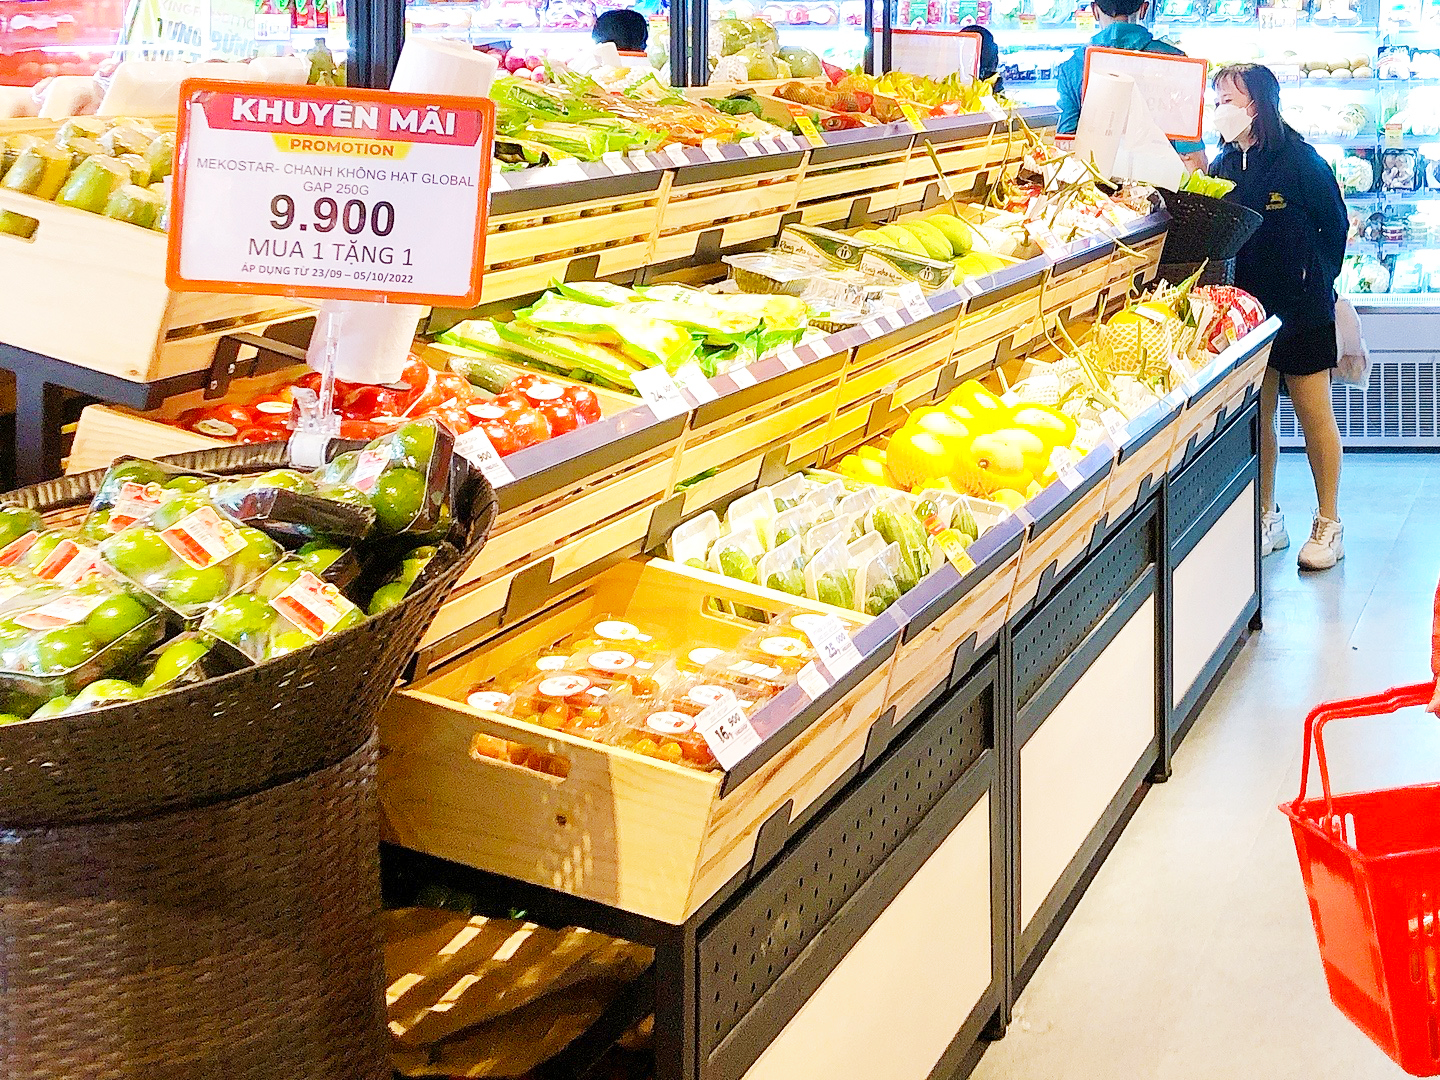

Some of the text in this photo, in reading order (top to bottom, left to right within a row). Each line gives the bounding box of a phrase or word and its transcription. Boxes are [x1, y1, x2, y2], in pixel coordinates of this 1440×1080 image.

[389, 105, 456, 136] MÃI
[290, 139, 395, 157] PROMOTION
[196, 157, 475, 188] MEKOSTAR- CHANH KHÔNG HẠT GLOBAL
[303, 180, 370, 196] GAP 250G
[270, 194, 395, 237] 9.900
[249, 237, 414, 267] MUA 1 TẶNG 1
[240, 262, 256, 274] ÁP
[258, 265, 291, 278] DỤNG
[293, 263, 310, 277] TỪ
[311, 267, 343, 279] 23/09
[353, 270, 414, 284] 05/10/2022
